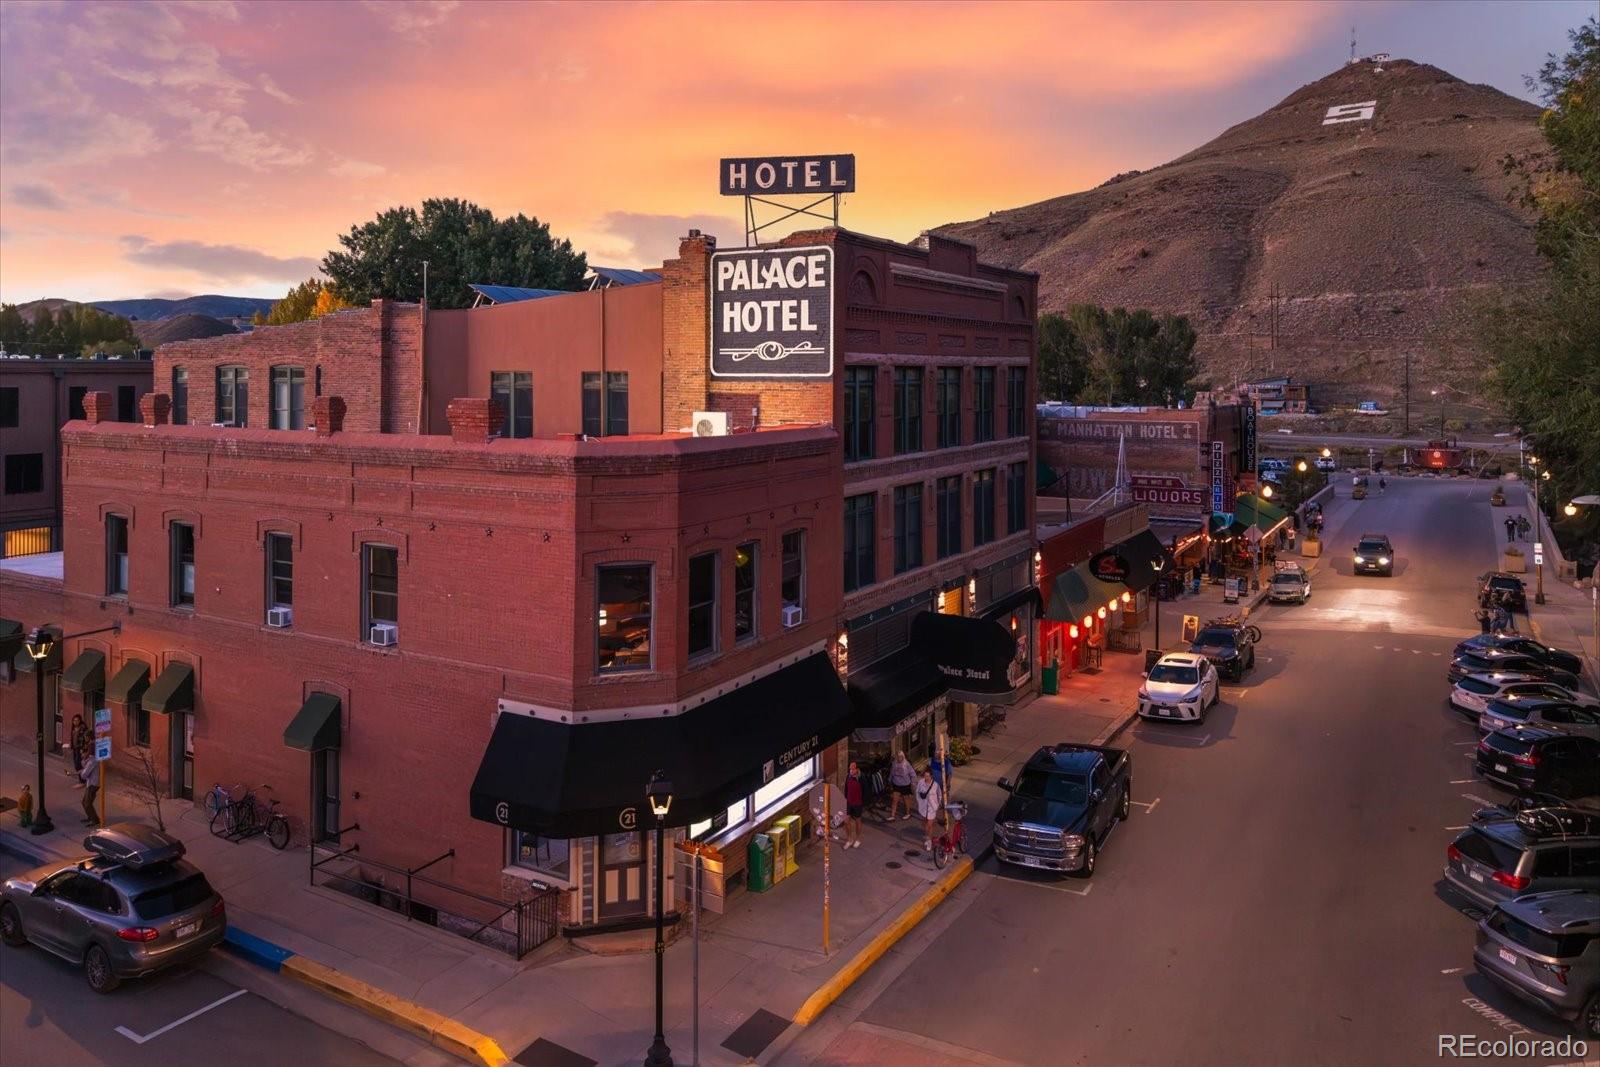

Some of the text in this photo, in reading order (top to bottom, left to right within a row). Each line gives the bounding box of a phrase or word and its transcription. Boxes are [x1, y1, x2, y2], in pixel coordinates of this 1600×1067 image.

[729, 160, 847, 189] HOTEL
[717, 254, 826, 292] PALACE
[722, 299, 818, 333] HOTEL
[1056, 422, 1178, 440] MANHATTAN HOTEL
[1134, 489, 1202, 504] LIQUORS
[779, 740, 811, 766] CENTURY
[1462, 997, 1533, 1035] COMPACT
